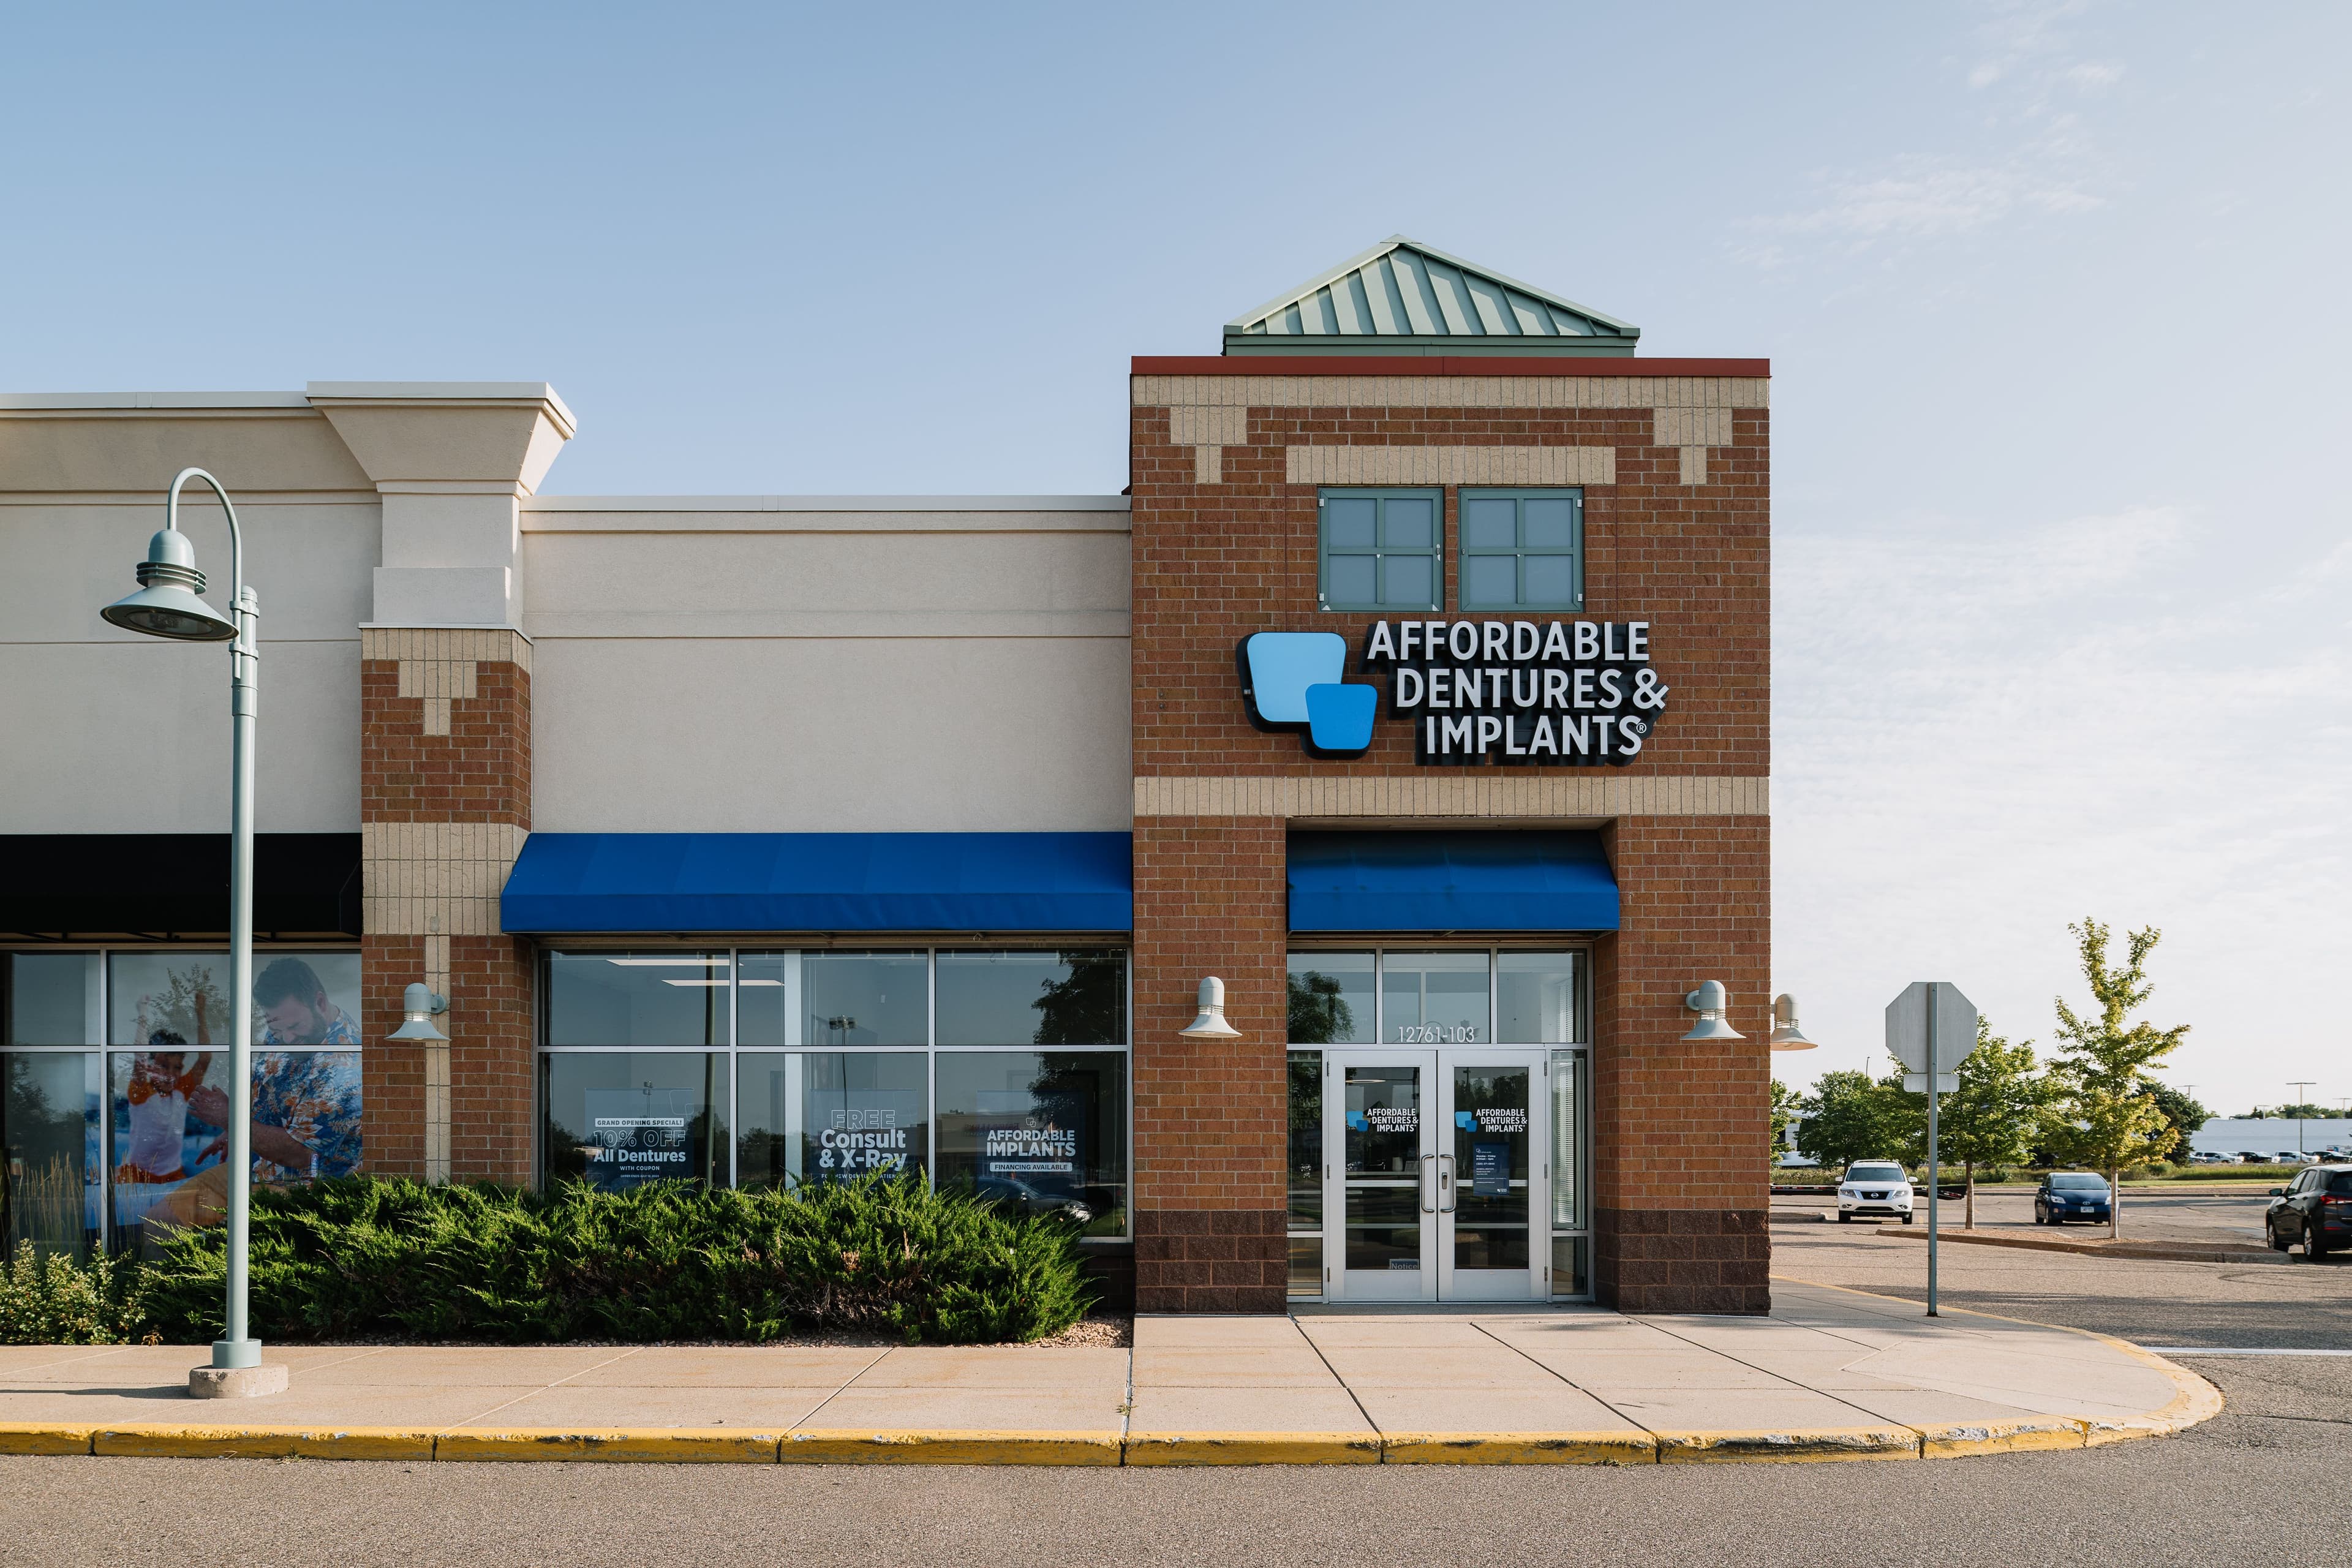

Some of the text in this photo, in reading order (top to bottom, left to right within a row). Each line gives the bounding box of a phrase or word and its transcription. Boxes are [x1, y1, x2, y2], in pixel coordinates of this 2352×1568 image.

[1366, 620, 1649, 661] AFFORDABLE
[1396, 668, 1670, 710] DENTURES &
[1398, 1026, 1474, 1042] 12761-103
[831, 1109, 895, 1129] FREE
[593, 1130, 686, 1147] 10% OFF
[821, 1129, 906, 1148] Consult
[987, 1129, 1075, 1141] AFFORDABLE
[594, 1149, 686, 1163] All Dentures
[987, 1142, 1076, 1156] IMPLANTS
[819, 1148, 907, 1171] & X-Ray
